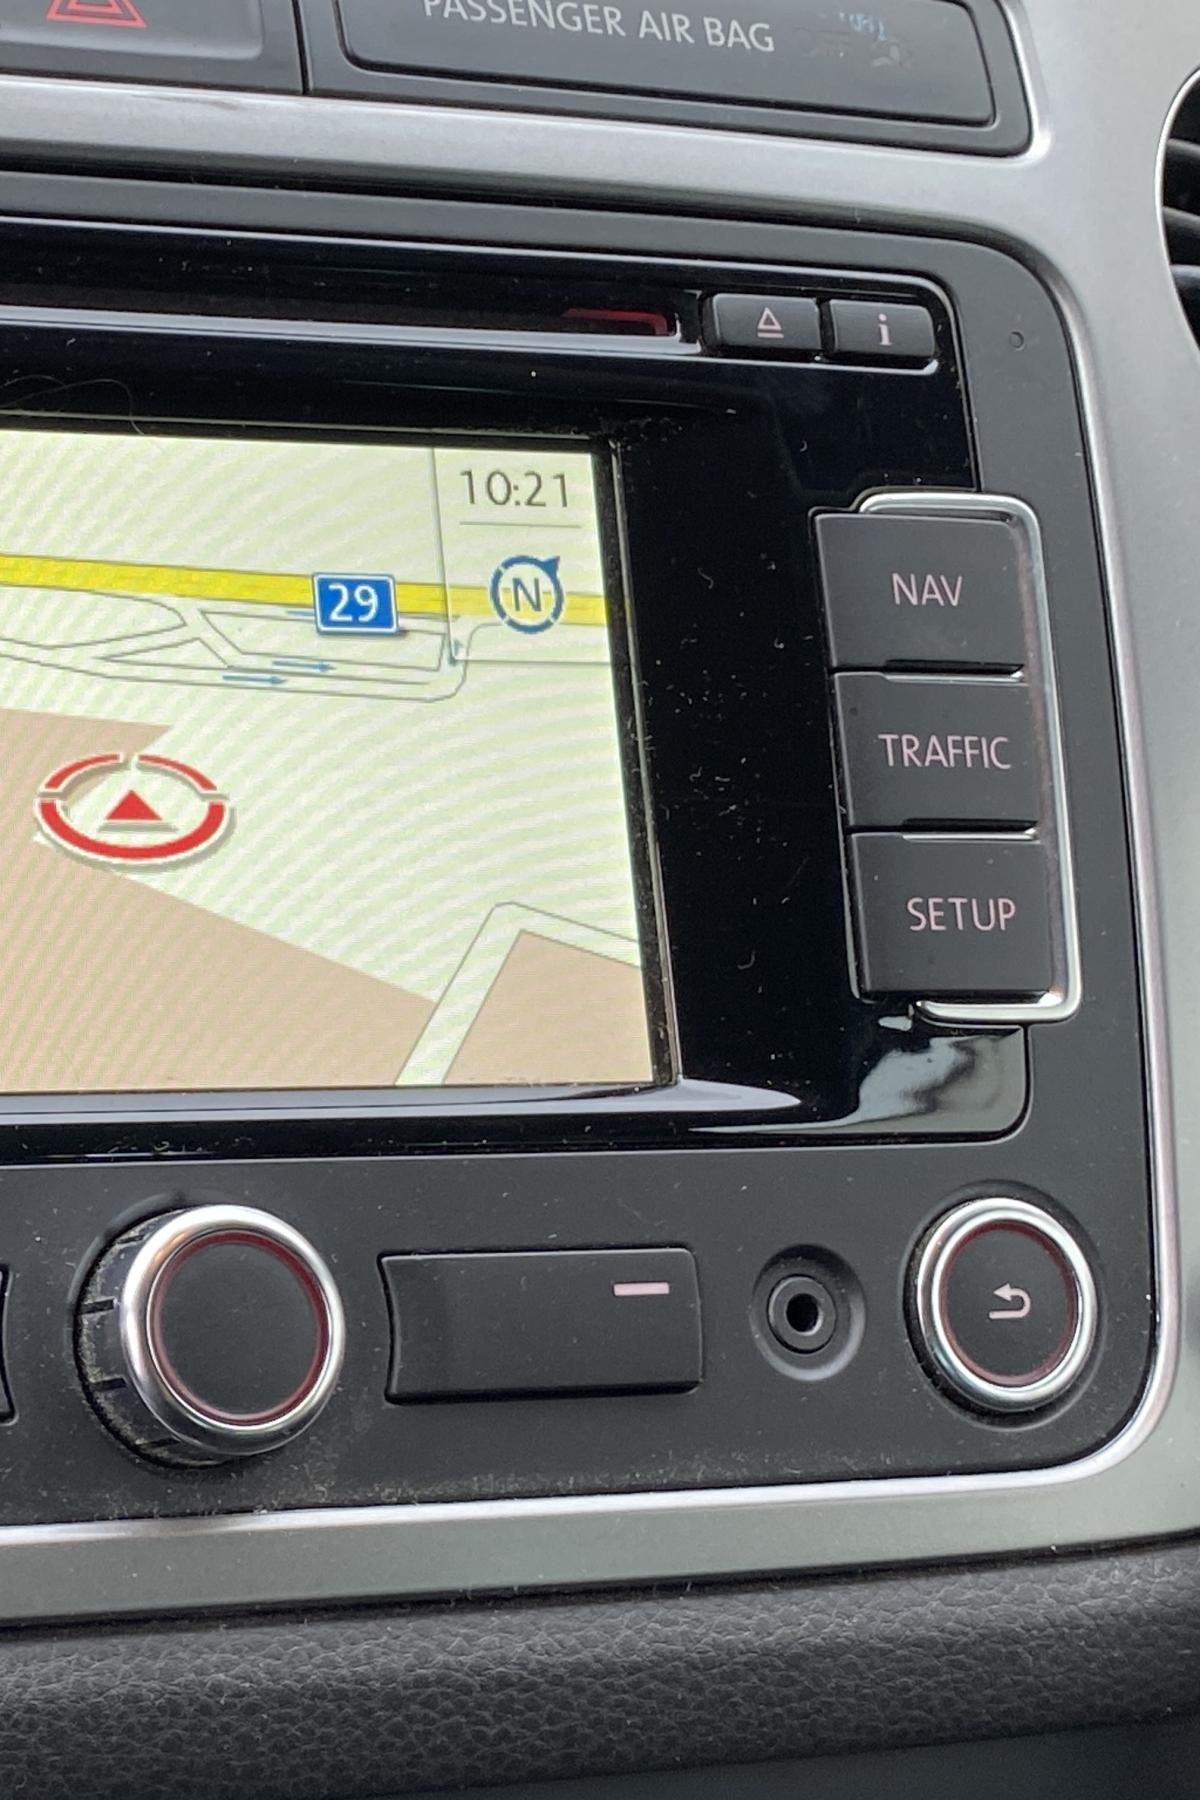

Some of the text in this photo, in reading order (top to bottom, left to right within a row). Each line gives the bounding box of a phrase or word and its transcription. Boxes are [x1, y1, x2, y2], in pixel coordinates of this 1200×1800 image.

[423, 0, 775, 52] PASSENGER AIR BAG
[460, 469, 569, 508] 10:21
[328, 583, 379, 624] 29
[513, 577, 542, 613] N
[892, 573, 963, 606] NAV
[878, 734, 1012, 770] TRAFFIC
[907, 898, 1016, 931] SETUP
